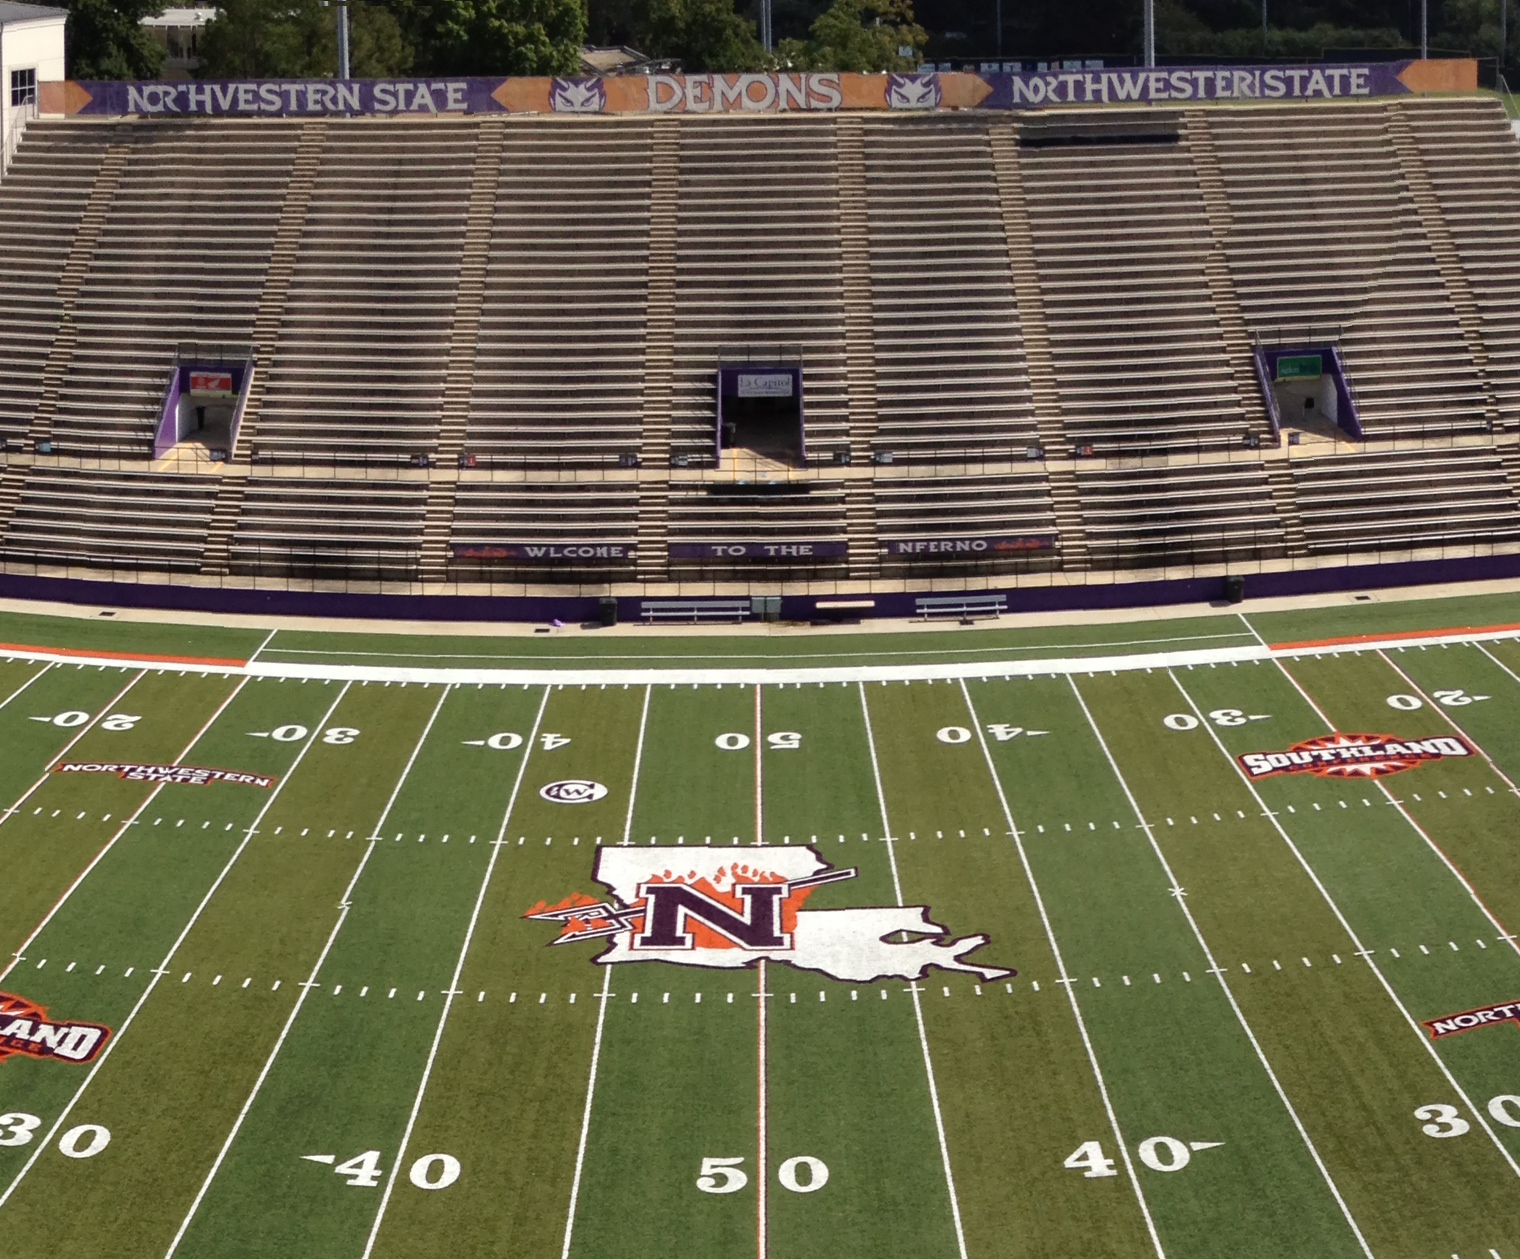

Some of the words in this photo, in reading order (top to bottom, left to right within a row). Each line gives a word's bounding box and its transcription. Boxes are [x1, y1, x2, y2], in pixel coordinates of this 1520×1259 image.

[647, 72, 843, 112] DEMONS
[1264, 68, 1370, 98] STATE
[711, 545, 747, 557] TO
[764, 545, 813, 556] THE
[1385, 689, 1476, 712] 20
[47, 710, 143, 732] 20
[1163, 708, 1248, 732] 30
[270, 724, 360, 746] 30
[487, 731, 572, 751] 40
[714, 731, 803, 751] 50
[935, 723, 1026, 746] 40
[1243, 737, 1469, 775] SOUTHLAND
[62, 763, 271, 787] NORTHWESTERN
[127, 772, 207, 785] STATE
[630, 881, 799, 951] N
[1063, 1135, 1194, 1179] 40
[332, 1149, 463, 1190] 40
[695, 1155, 830, 1194] 50
